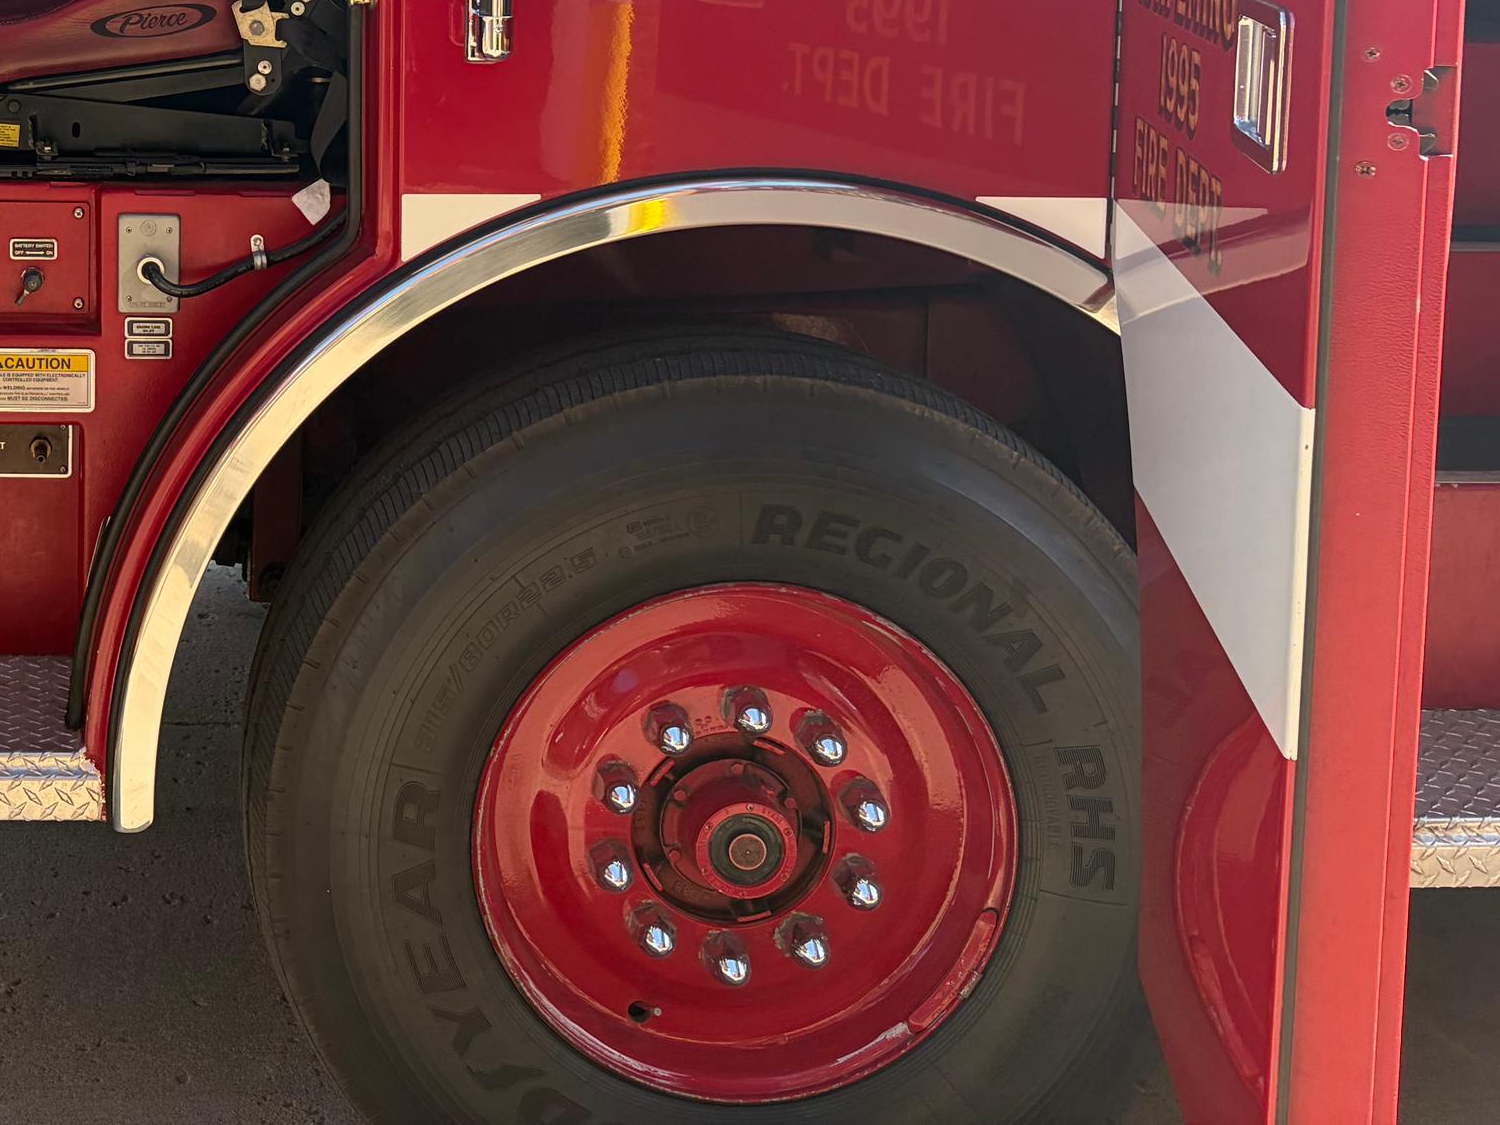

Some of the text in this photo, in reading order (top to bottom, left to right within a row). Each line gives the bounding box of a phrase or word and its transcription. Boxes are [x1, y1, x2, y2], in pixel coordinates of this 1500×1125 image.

[119, 11, 189, 34] Pierce
[1158, 32, 1201, 140] 1995
[1133, 116, 1168, 217] FIRE
[4, 357, 71, 369] CAUTION
[751, 503, 1066, 715] REGIONAL
[1054, 744, 1116, 891] RHS
